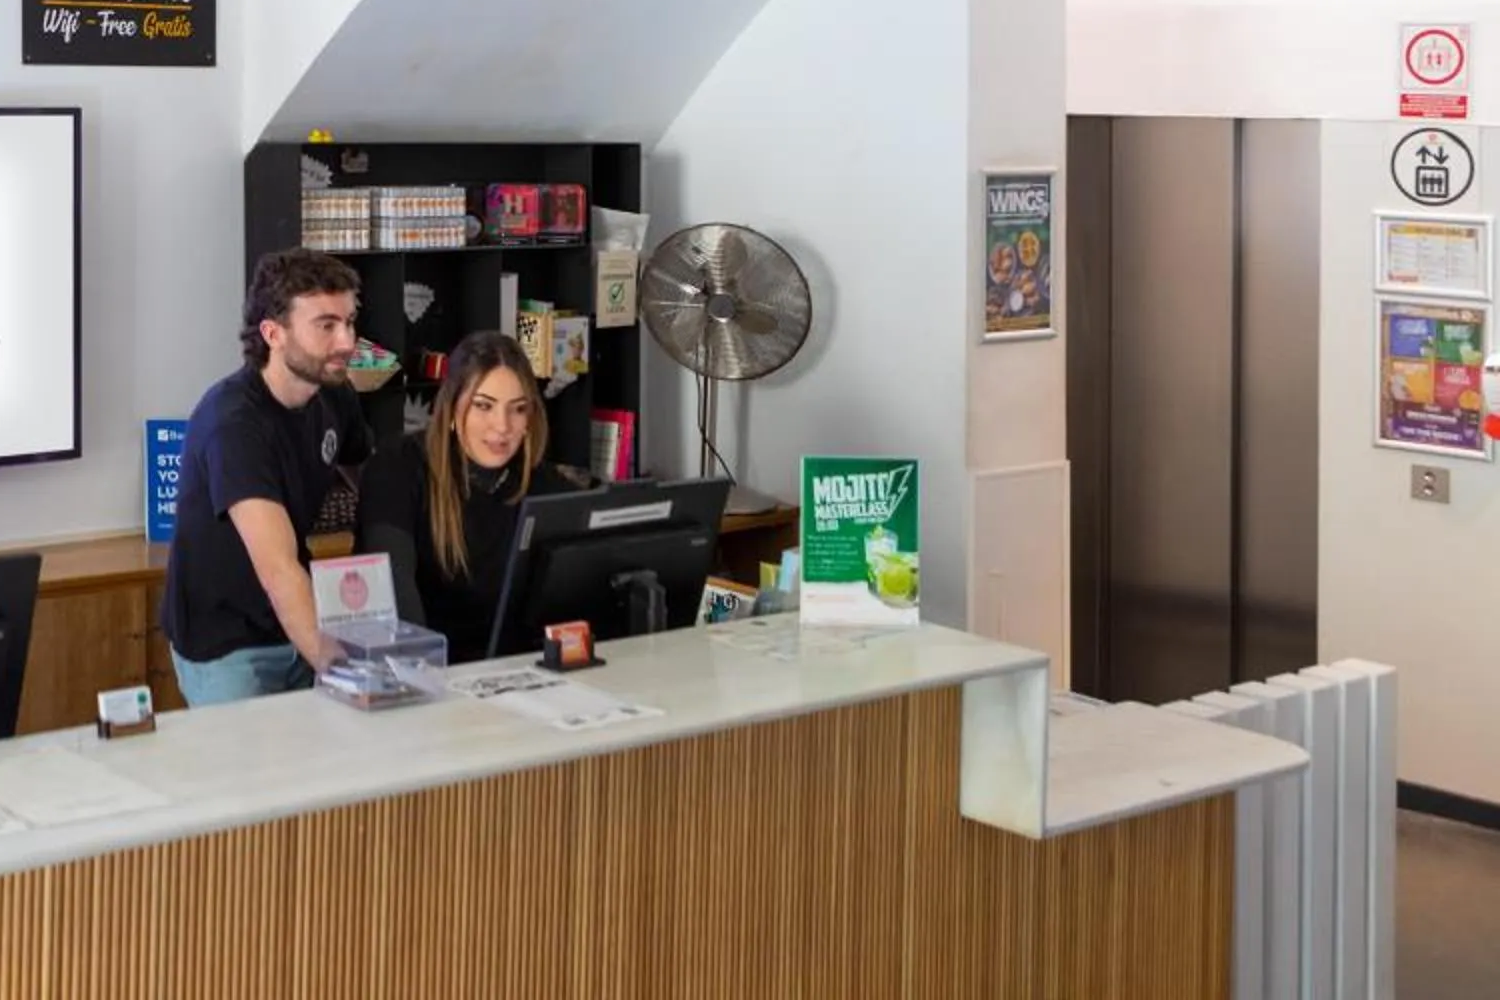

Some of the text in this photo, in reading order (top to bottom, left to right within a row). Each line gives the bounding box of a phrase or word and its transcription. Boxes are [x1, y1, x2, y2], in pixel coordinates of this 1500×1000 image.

[43, 9, 80, 43] Wifi
[97, 11, 137, 37] Free
[143, 10, 192, 39] Gratis
[990, 189, 1046, 213] WINGS
[157, 454, 182, 467] STO
[157, 470, 179, 482] YO
[813, 472, 889, 504] MOJITO
